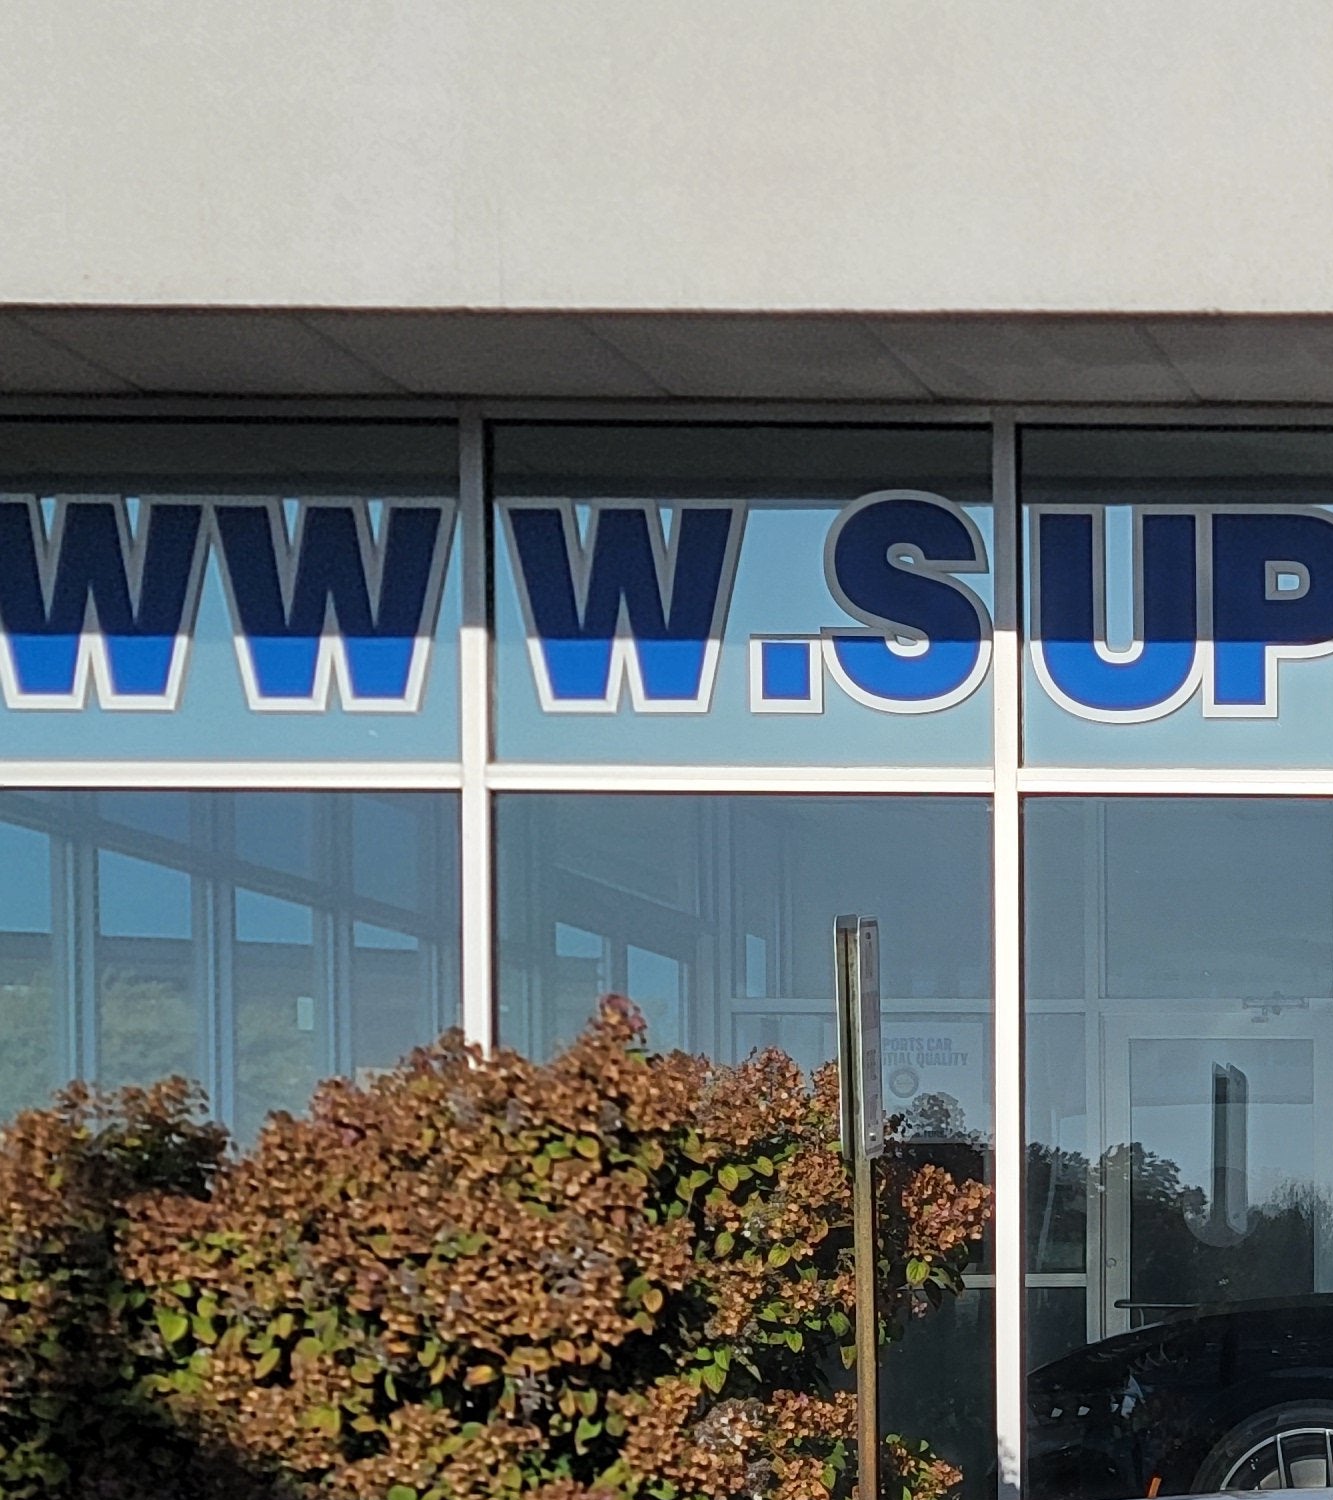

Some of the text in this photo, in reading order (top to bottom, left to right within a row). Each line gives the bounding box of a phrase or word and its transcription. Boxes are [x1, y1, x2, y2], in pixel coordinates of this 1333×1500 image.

[883, 1037, 952, 1052] PORTS CAR
[917, 1052, 968, 1068] QUALITY
